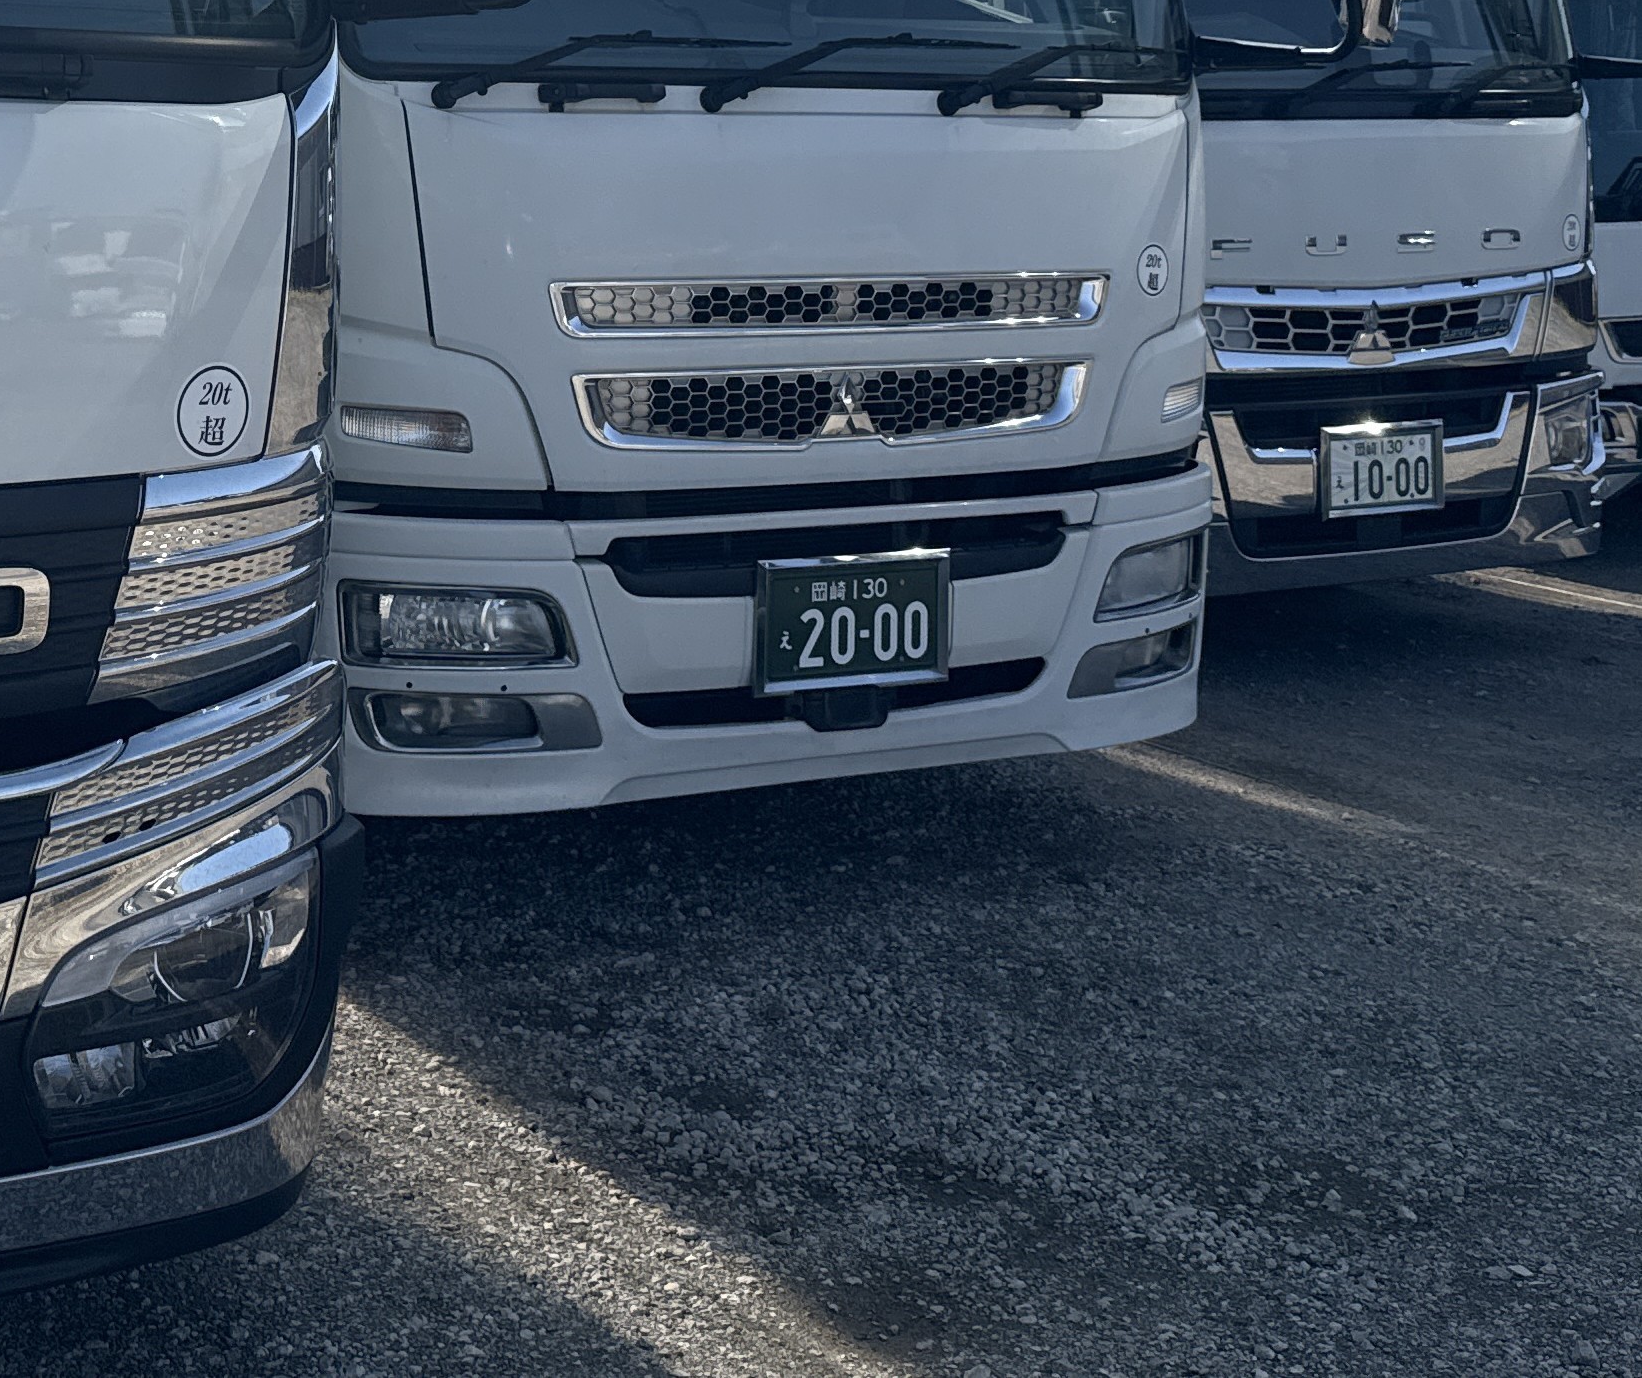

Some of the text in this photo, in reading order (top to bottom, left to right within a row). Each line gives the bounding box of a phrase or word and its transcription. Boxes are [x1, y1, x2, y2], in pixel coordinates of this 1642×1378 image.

[1209, 228, 1522, 260] FUSO
[198, 381, 233, 406] 20t
[198, 415, 226, 446] 超
[1380, 439, 1403, 455] 130
[1353, 455, 1429, 501] 10-00
[811, 577, 888, 602] 岡崎 130
[779, 600, 929, 668] え 20-00
